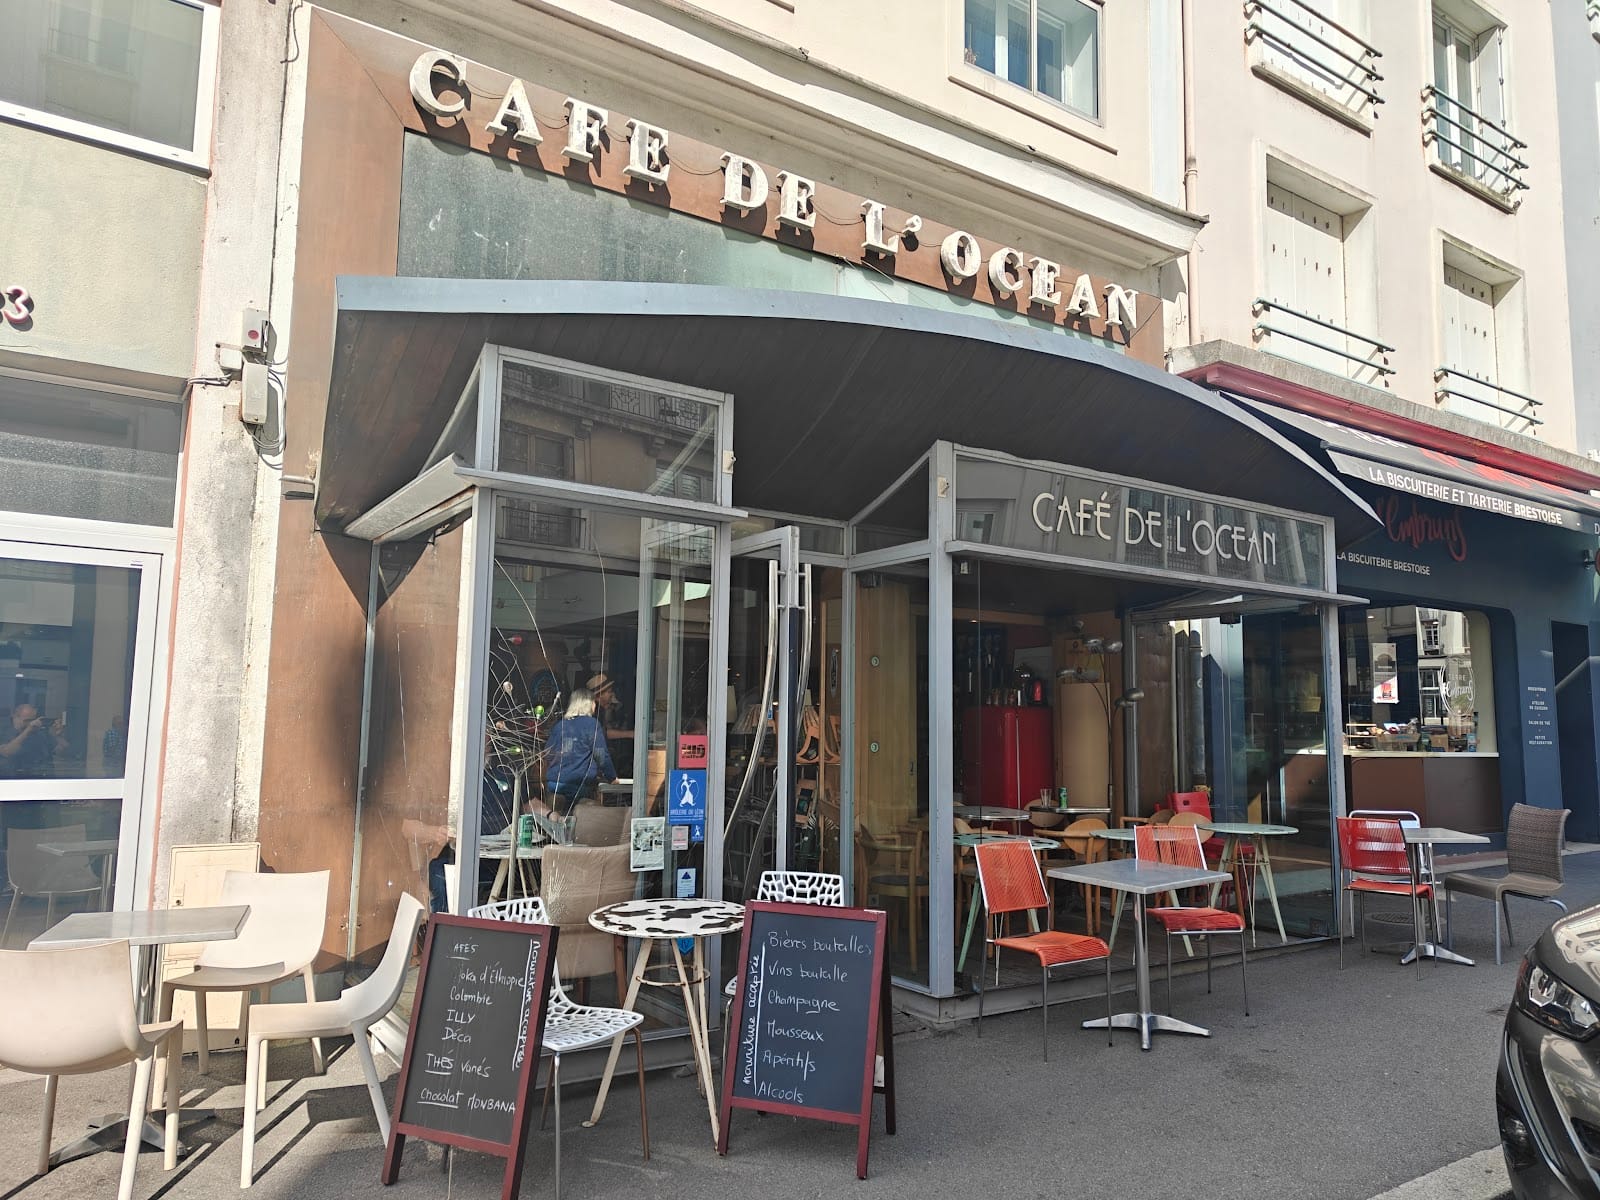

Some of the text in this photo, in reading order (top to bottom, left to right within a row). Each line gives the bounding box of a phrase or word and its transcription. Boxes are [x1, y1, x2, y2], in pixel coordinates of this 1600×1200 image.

[409, 51, 1139, 330] CAFE DE L'OCEAN
[1369, 467, 1563, 525] LA BISCUITERIE ET TARTERIE BRESTOISE
[1032, 491, 1277, 566] CAFÉ DE L'OCEAN
[1348, 552, 1393, 569] BISCUITERIE
[1393, 560, 1431, 575] BRESTOISE
[768, 960, 793, 977] Vins
[449, 986, 493, 1005] Colombie
[768, 989, 840, 1014] Champagne
[446, 1009, 476, 1025] ILLY
[442, 1026, 472, 1044] Déca
[767, 1019, 824, 1042] Mousseux
[757, 1081, 804, 1104] Alcools
